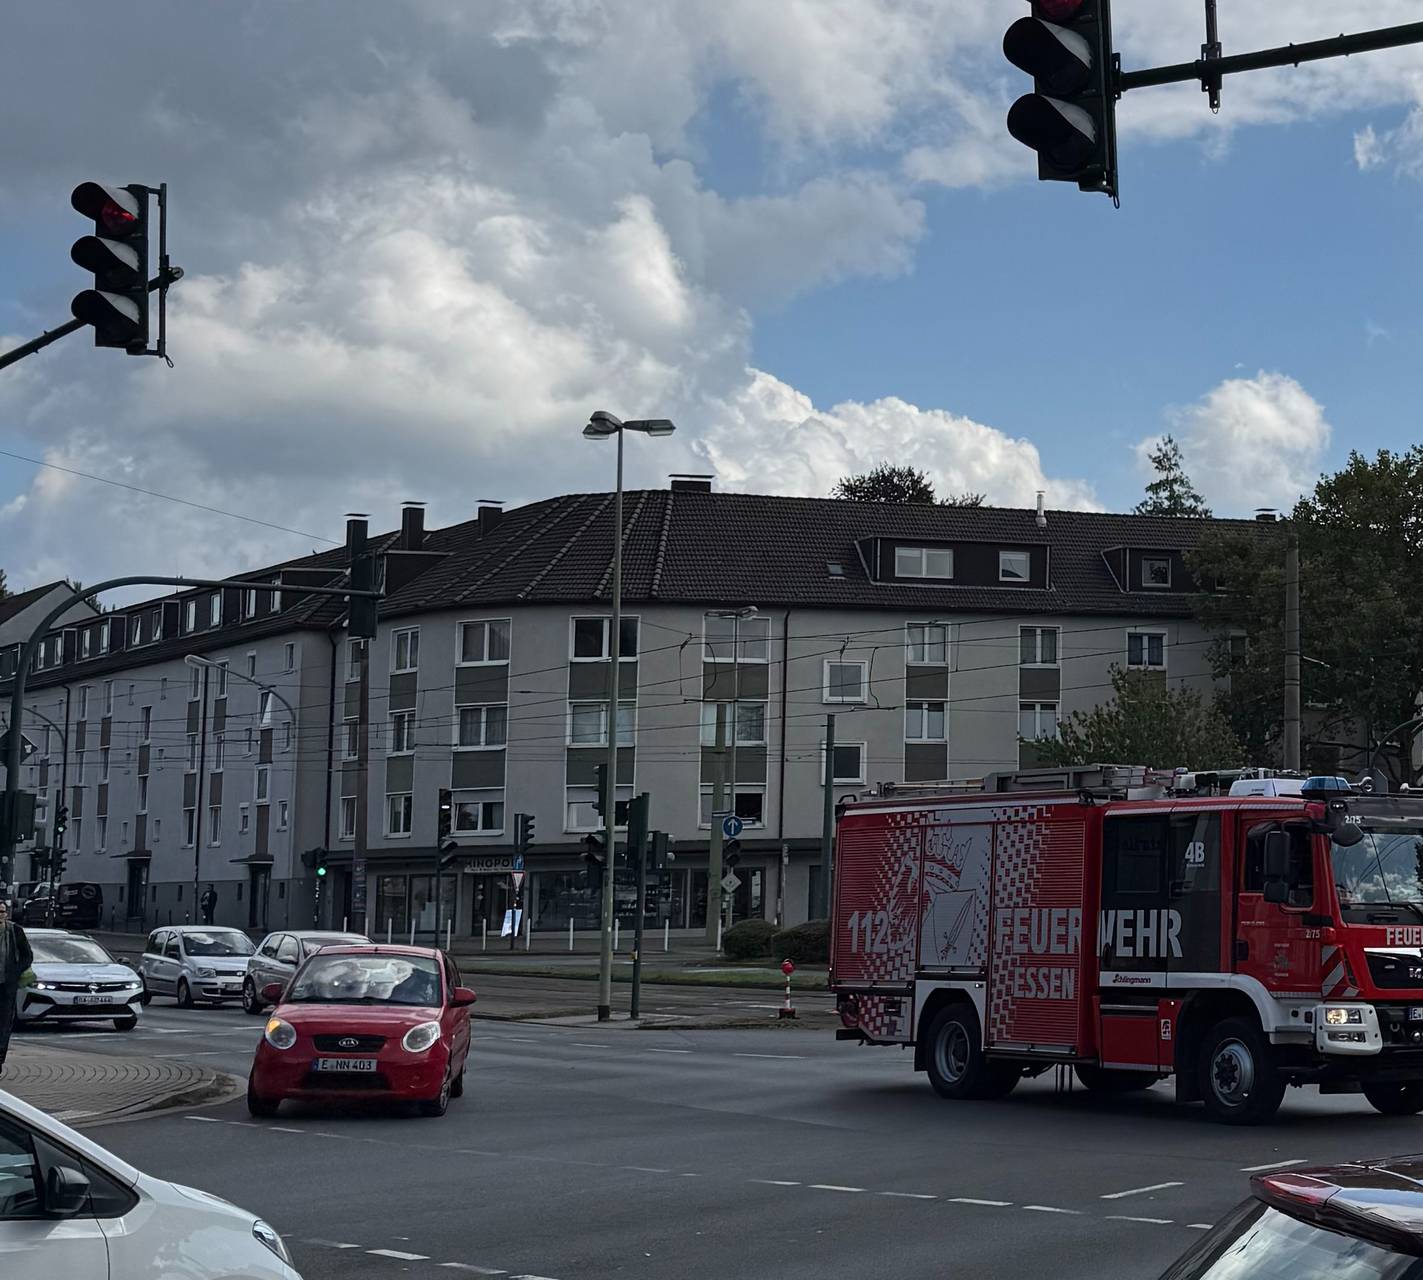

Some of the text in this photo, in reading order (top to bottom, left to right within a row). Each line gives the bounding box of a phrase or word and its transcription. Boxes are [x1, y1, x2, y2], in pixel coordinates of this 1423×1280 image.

[1184, 841, 1205, 863] 4B
[847, 910, 889, 953] 112
[1013, 966, 1075, 999] ESSEN
[321, 1060, 328, 1069] E
[352, 1060, 372, 1070] 403
